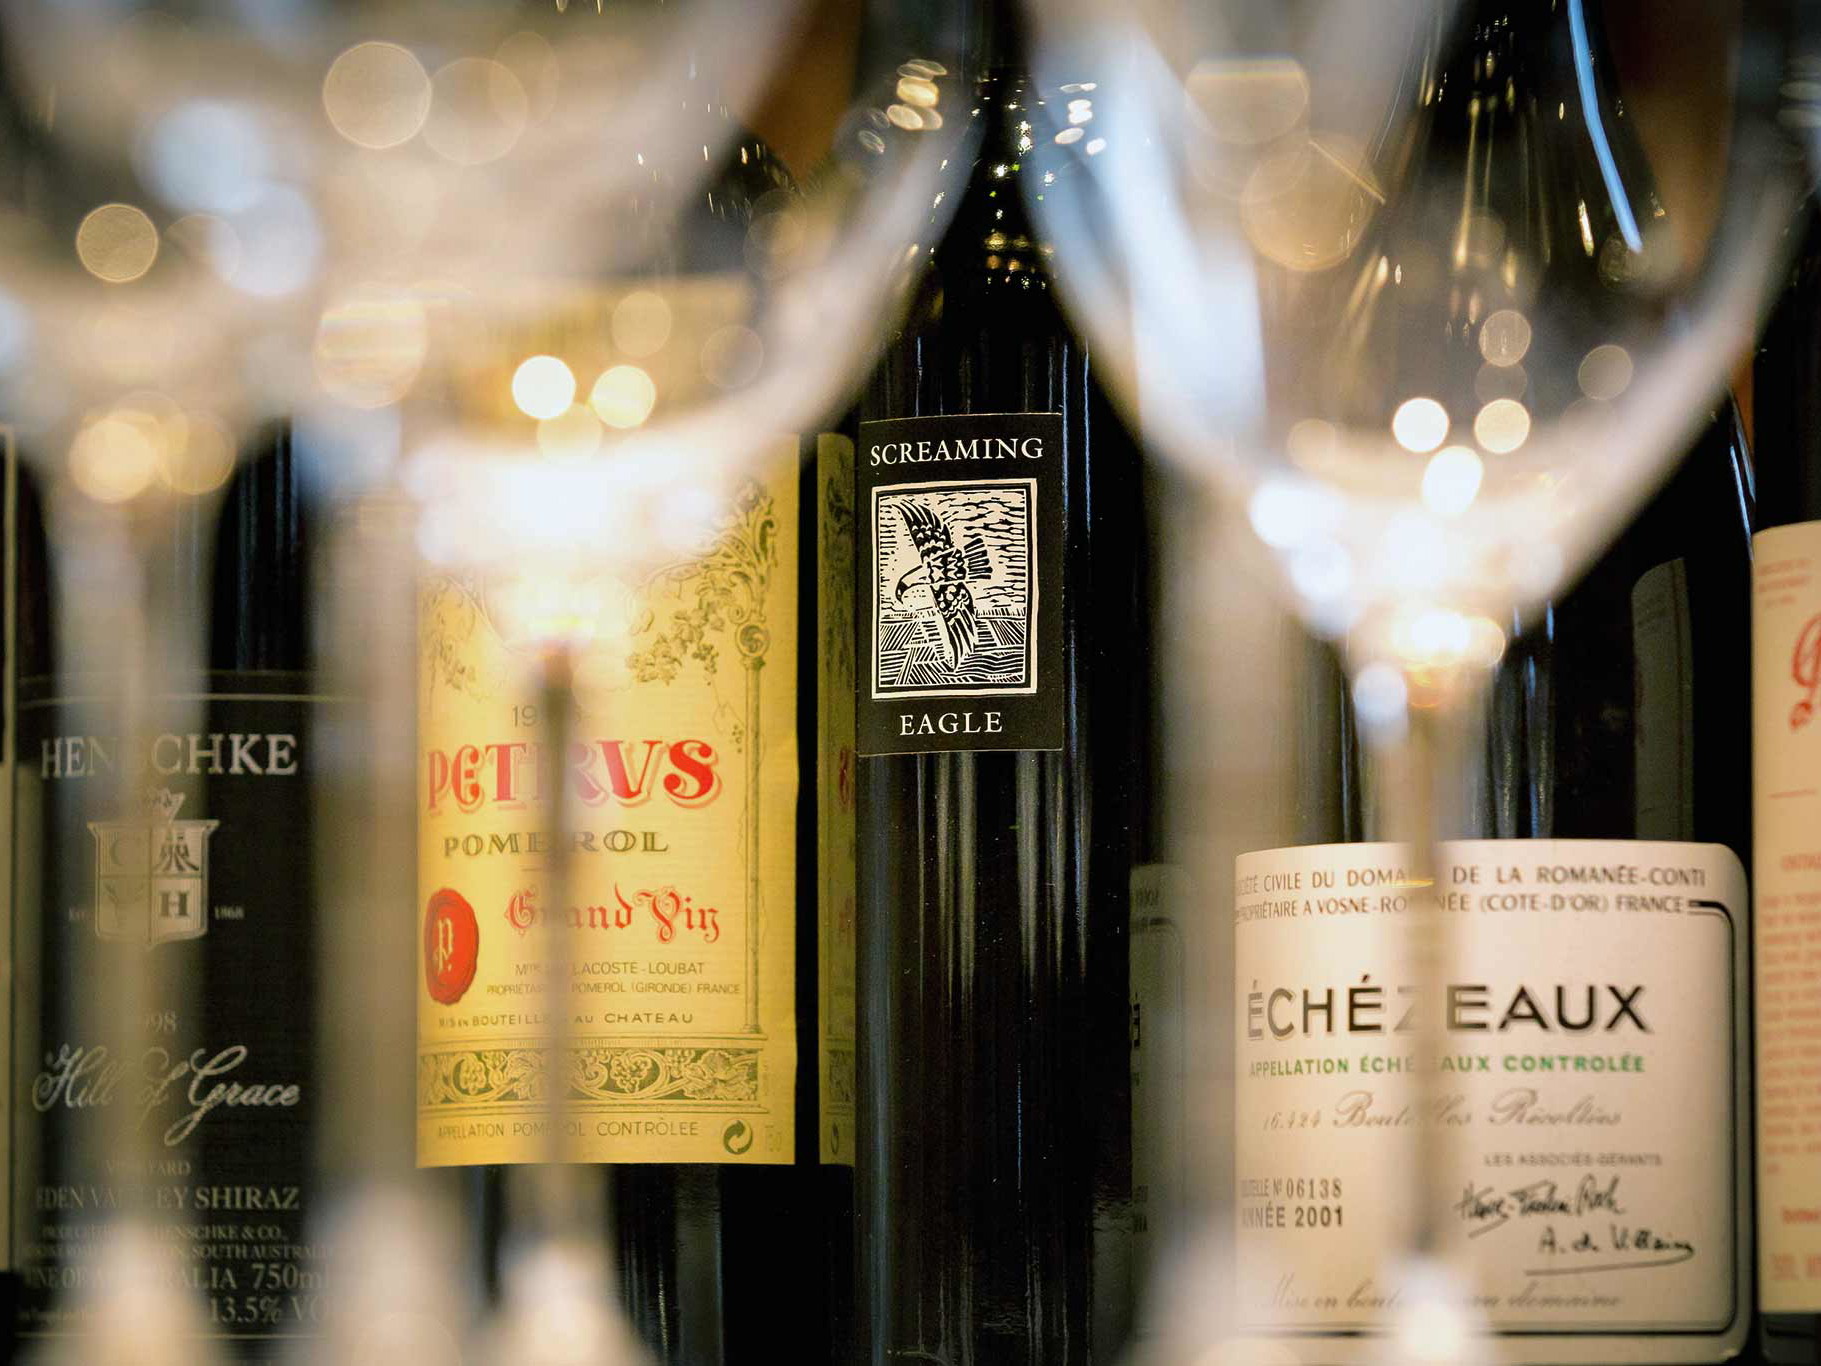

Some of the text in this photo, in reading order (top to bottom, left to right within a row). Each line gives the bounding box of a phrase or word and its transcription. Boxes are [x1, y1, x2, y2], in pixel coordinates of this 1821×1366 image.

[871, 438, 1043, 466] SCREAMING
[899, 712, 1002, 736] EAGLE
[42, 733, 298, 779] HENCHKE
[1264, 872, 1302, 893] CIVILE
[1312, 871, 1334, 889] DU
[1452, 866, 1480, 885] DE
[1496, 866, 1523, 885] LA
[1616, 895, 1683, 913] FRANCE
[631, 980, 692, 995] (GIRONDE)
[697, 982, 740, 995] FRANCE
[575, 1015, 594, 1024] AU
[604, 1012, 694, 1025] CHATEAU
[1250, 1058, 1349, 1077] APPELLATION
[163, 1045, 300, 1146] Grace
[195, 1186, 299, 1211] SHIRAZ
[1286, 1177, 1343, 1200] 06138
[1294, 1204, 1343, 1228] 2001
[209, 1296, 282, 1324] 13.5%
